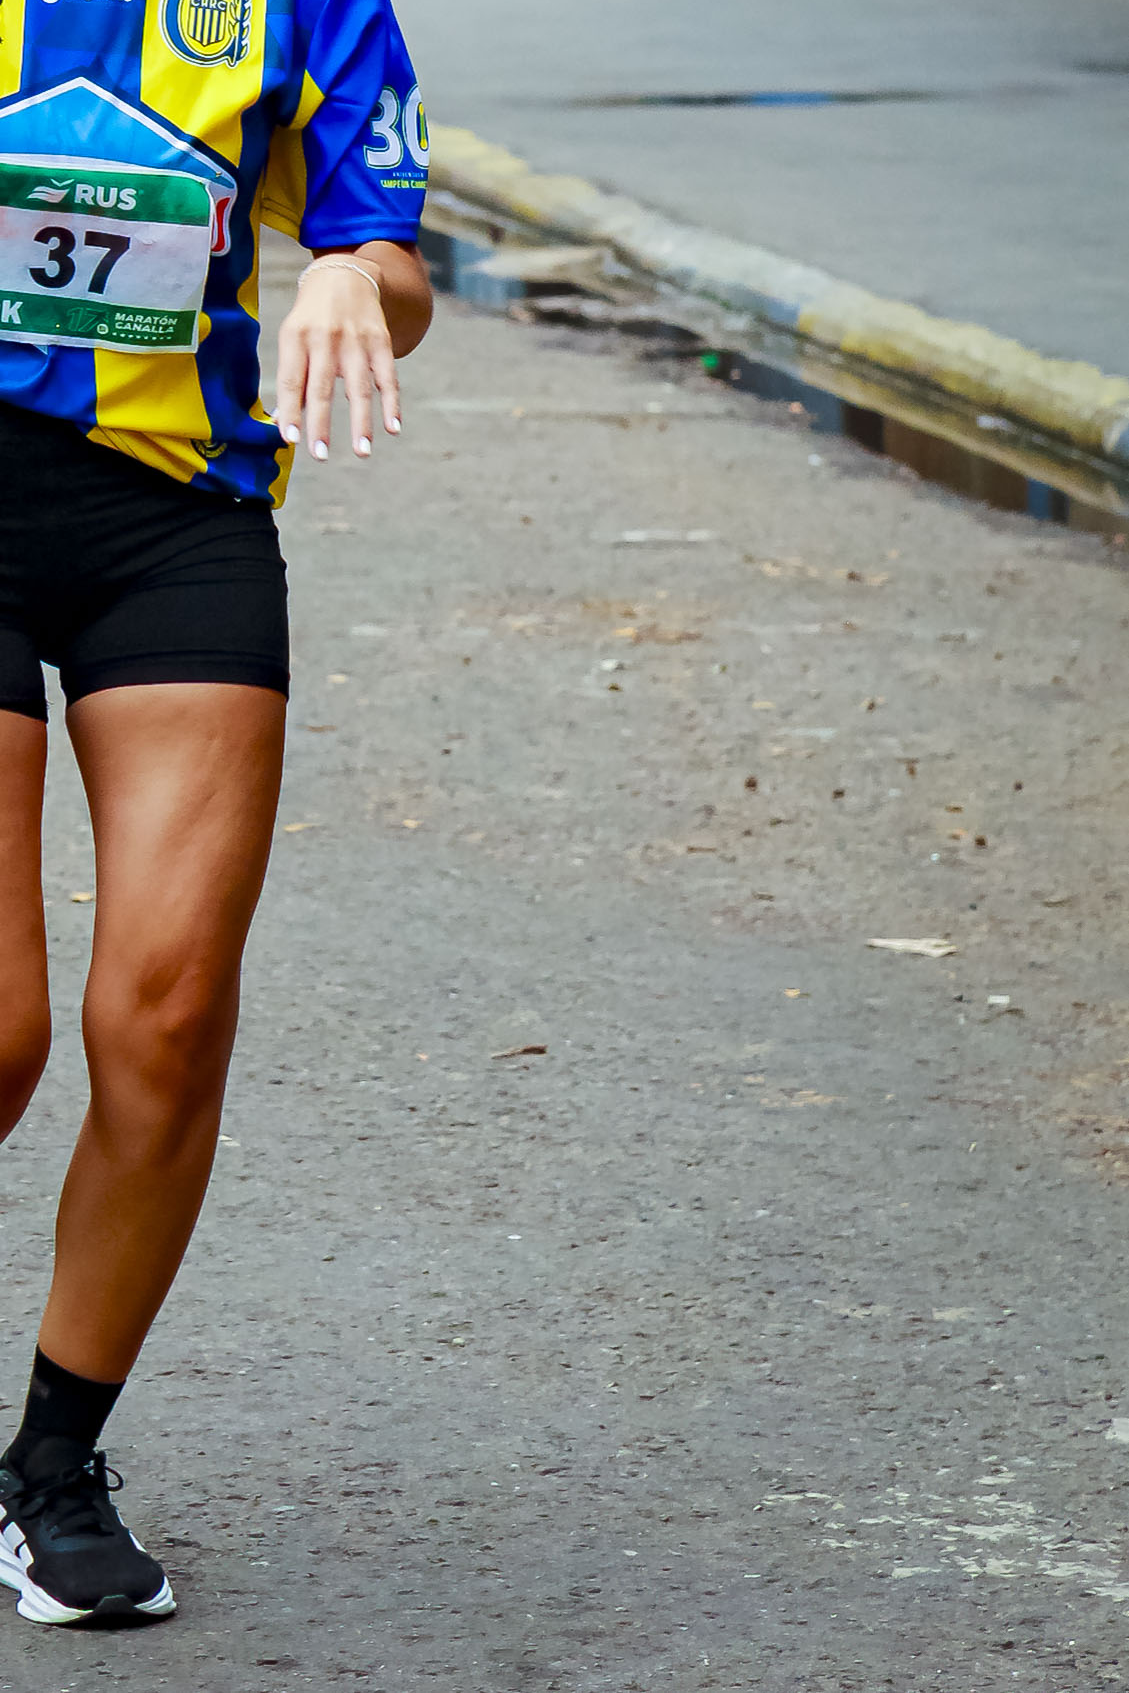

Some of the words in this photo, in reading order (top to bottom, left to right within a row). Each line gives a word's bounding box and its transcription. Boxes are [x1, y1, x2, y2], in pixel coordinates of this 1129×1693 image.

[74, 183, 137, 211] RUS
[28, 226, 131, 296] 37
[114, 312, 178, 326] MARATÓN
[114, 322, 175, 334] CANALLA
